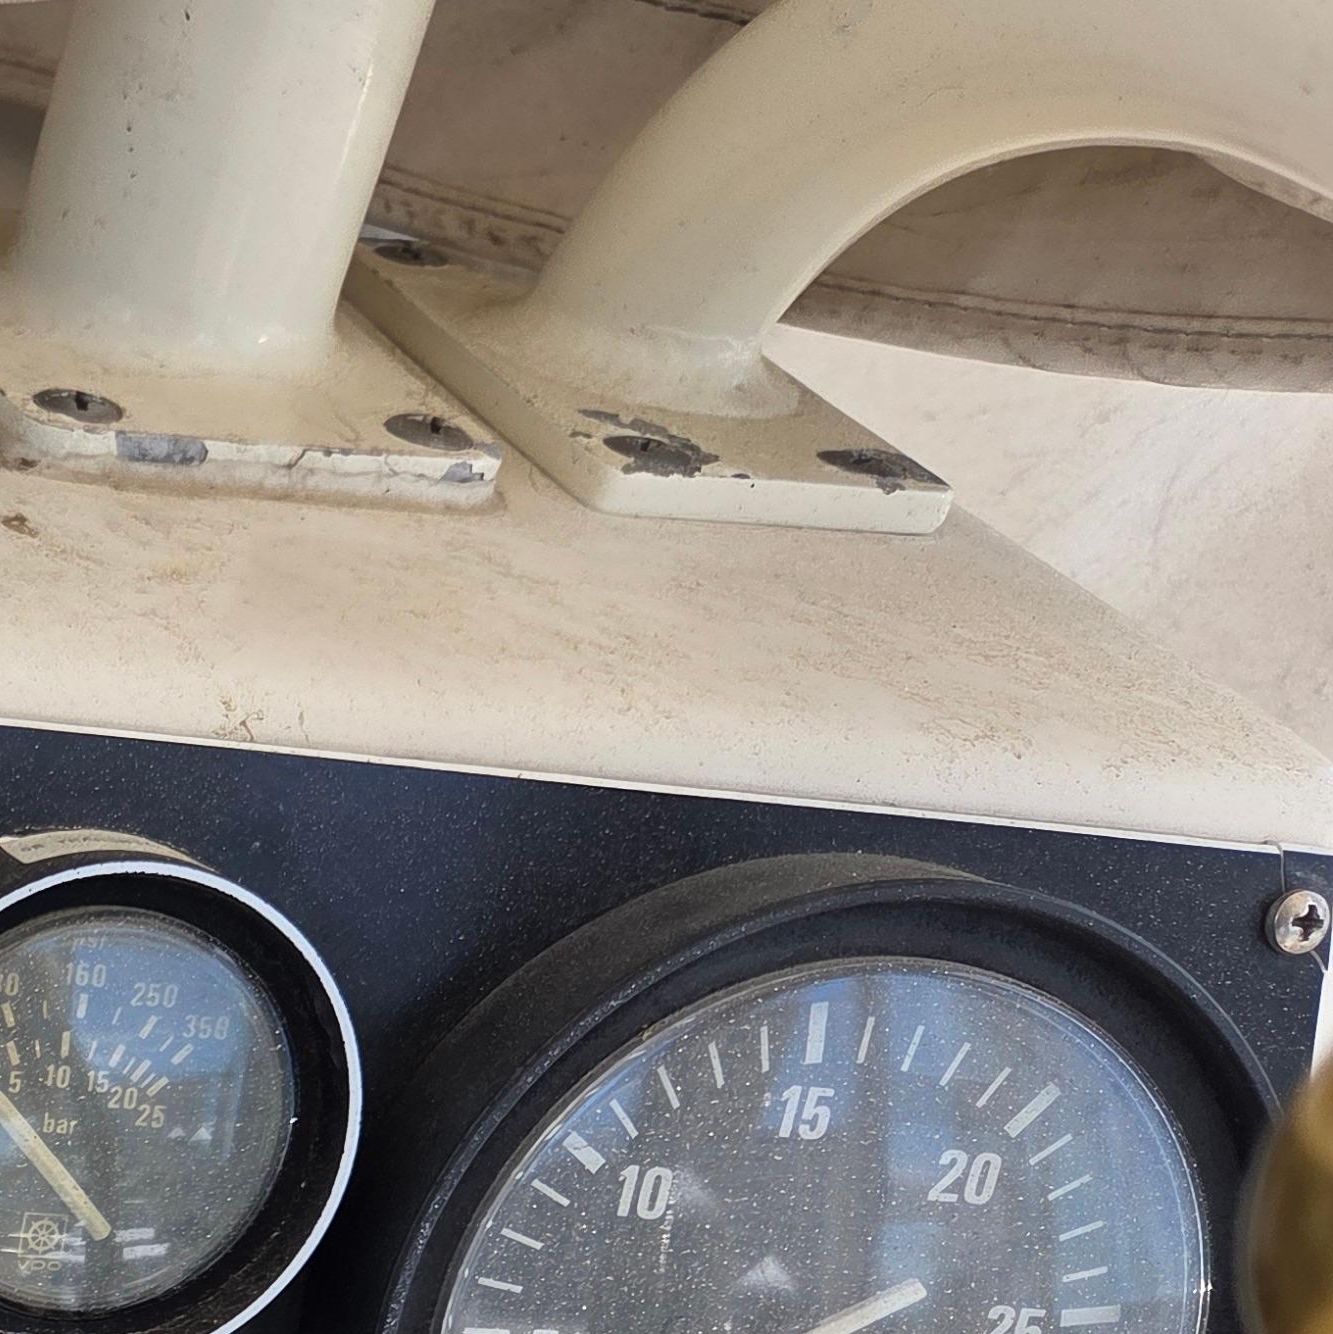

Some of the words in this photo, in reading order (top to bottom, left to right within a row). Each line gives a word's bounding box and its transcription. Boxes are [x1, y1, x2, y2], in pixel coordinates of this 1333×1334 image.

[66, 962, 107, 988] 160
[130, 982, 179, 1009] 250
[182, 1014, 230, 1040] 350
[7, 1070, 24, 1094] 5
[44, 1064, 72, 1089] 10
[86, 1069, 111, 1094] 15
[107, 1086, 139, 1110] 20
[42, 1111, 79, 1135] bar
[135, 1104, 167, 1129] 25
[777, 1086, 836, 1140] 15
[927, 1149, 1002, 1205] 20
[616, 1164, 674, 1221] 10
